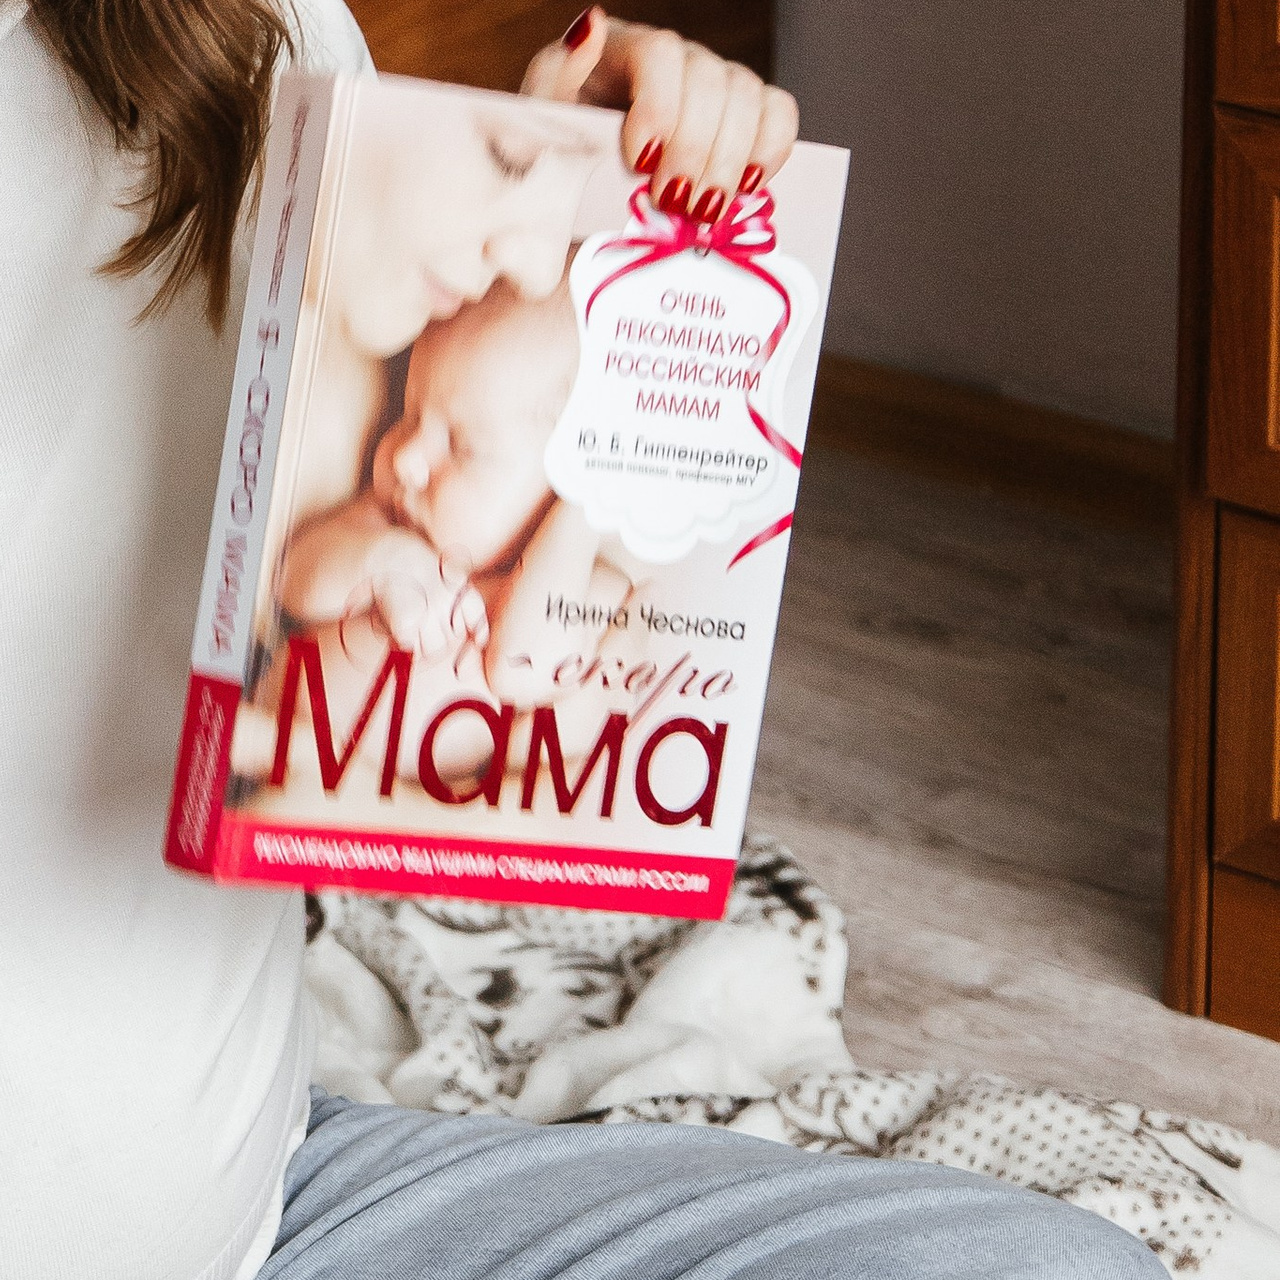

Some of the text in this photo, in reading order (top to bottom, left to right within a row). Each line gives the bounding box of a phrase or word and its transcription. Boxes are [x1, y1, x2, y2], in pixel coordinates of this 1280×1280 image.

[659, 288, 727, 321] ОЧЕНЬ
[614, 316, 761, 359] РЕКОМЕНДУЮ
[604, 349, 762, 394] РОССИЙСКИМ
[634, 387, 721, 423] МАМАМ
[634, 435, 769, 476] Гиппенрейтер
[546, 591, 746, 641] Ирина Чеснова
[269, 638, 729, 829] Мама
